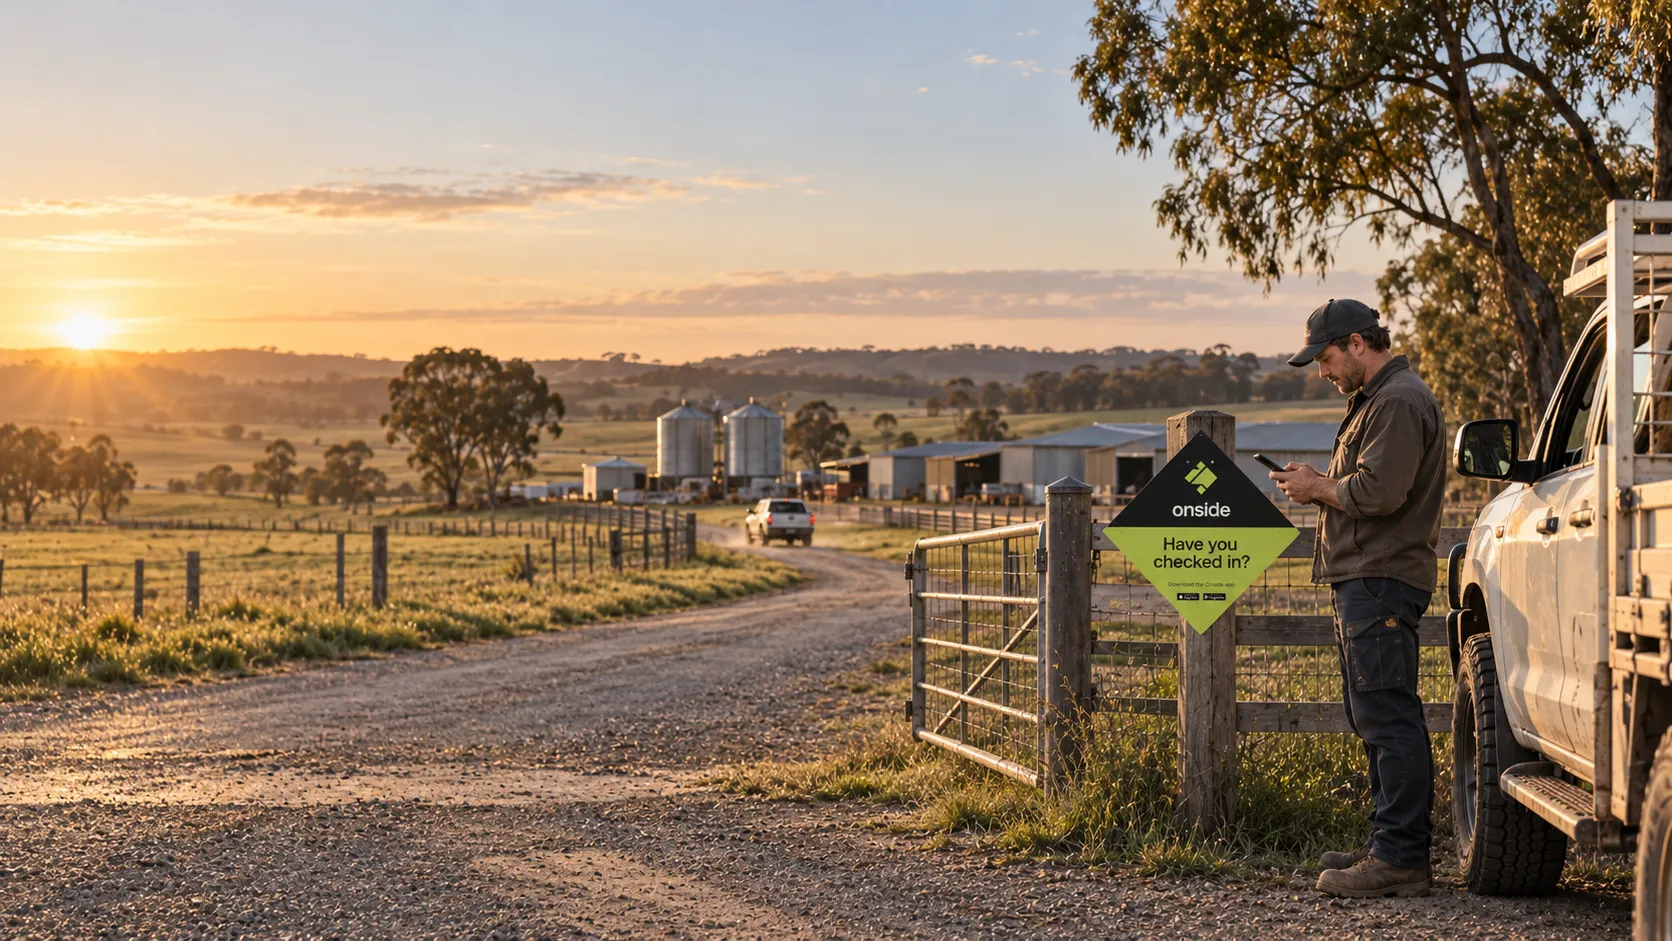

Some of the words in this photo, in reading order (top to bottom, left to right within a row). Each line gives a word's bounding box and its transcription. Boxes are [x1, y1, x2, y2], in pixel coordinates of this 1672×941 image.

[1172, 502, 1231, 517] onside
[1163, 537, 1204, 551] Have
[1208, 540, 1238, 554] you
[1153, 554, 1222, 569] checked
[1227, 554, 1251, 569] in?
